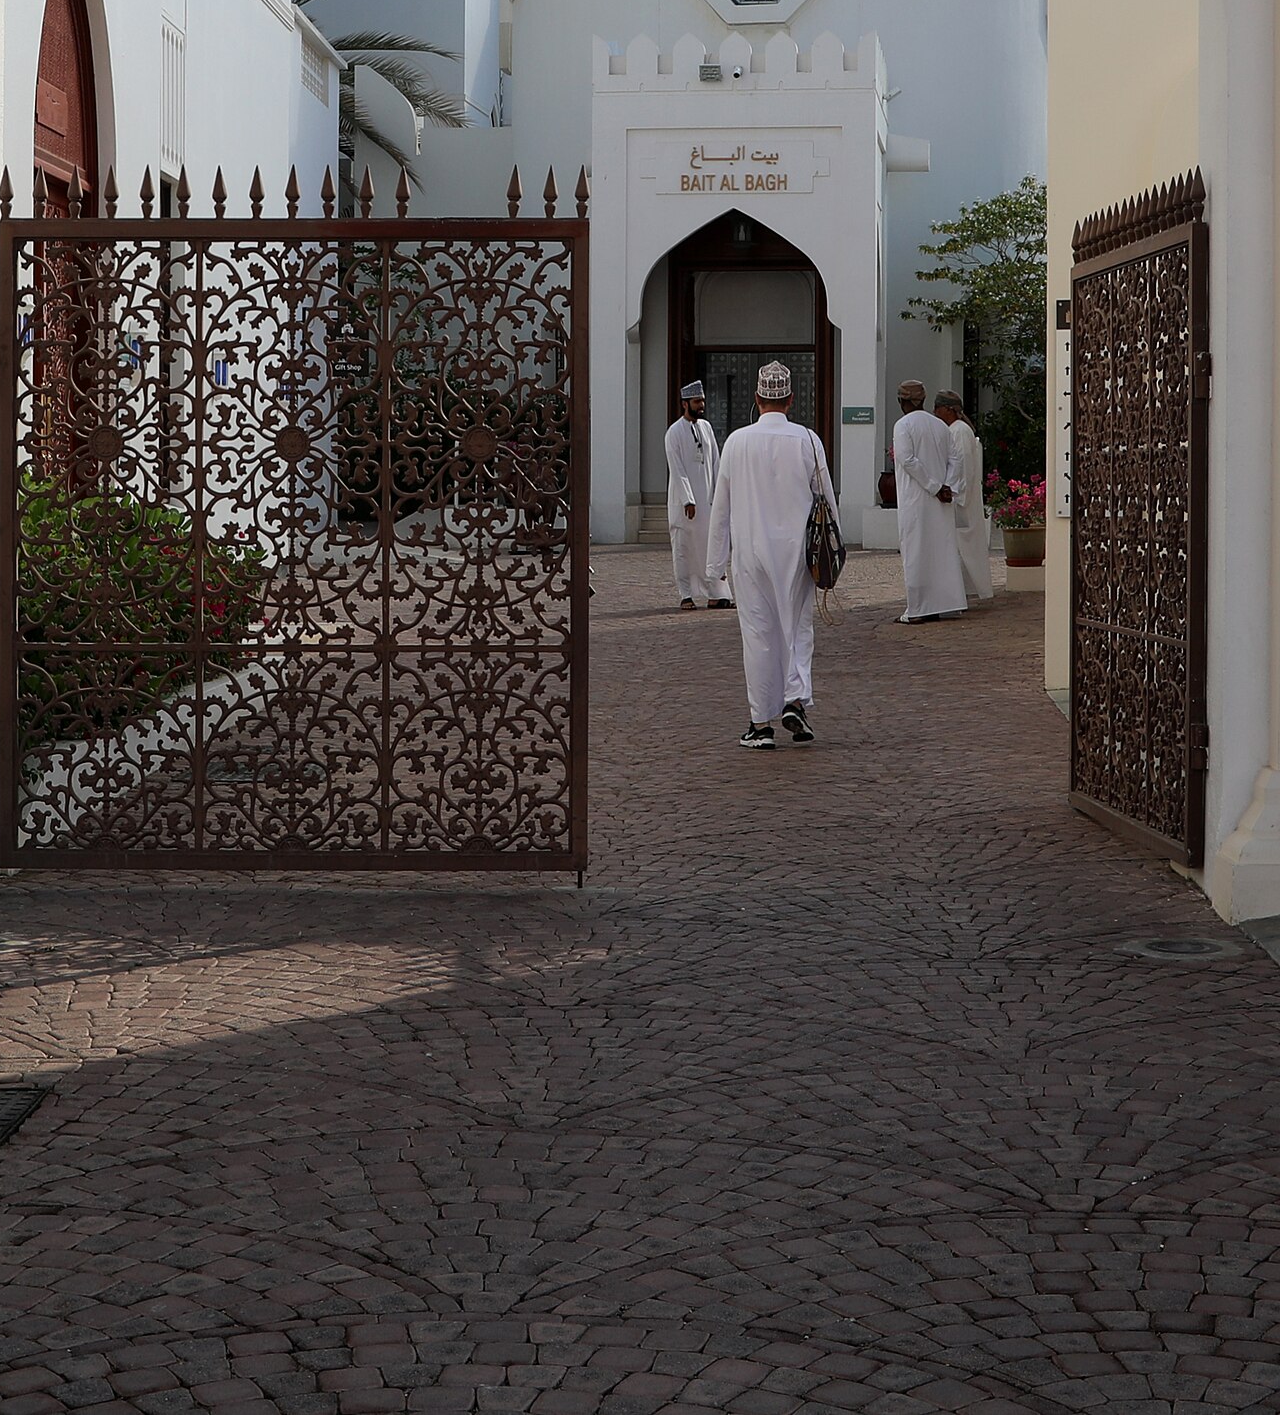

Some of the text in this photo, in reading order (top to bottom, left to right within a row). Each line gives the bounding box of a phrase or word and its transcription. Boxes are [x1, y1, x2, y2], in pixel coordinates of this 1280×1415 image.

[689, 145, 779, 169] بيت الباغ
[680, 174, 788, 191] BAIT AL BAGH
